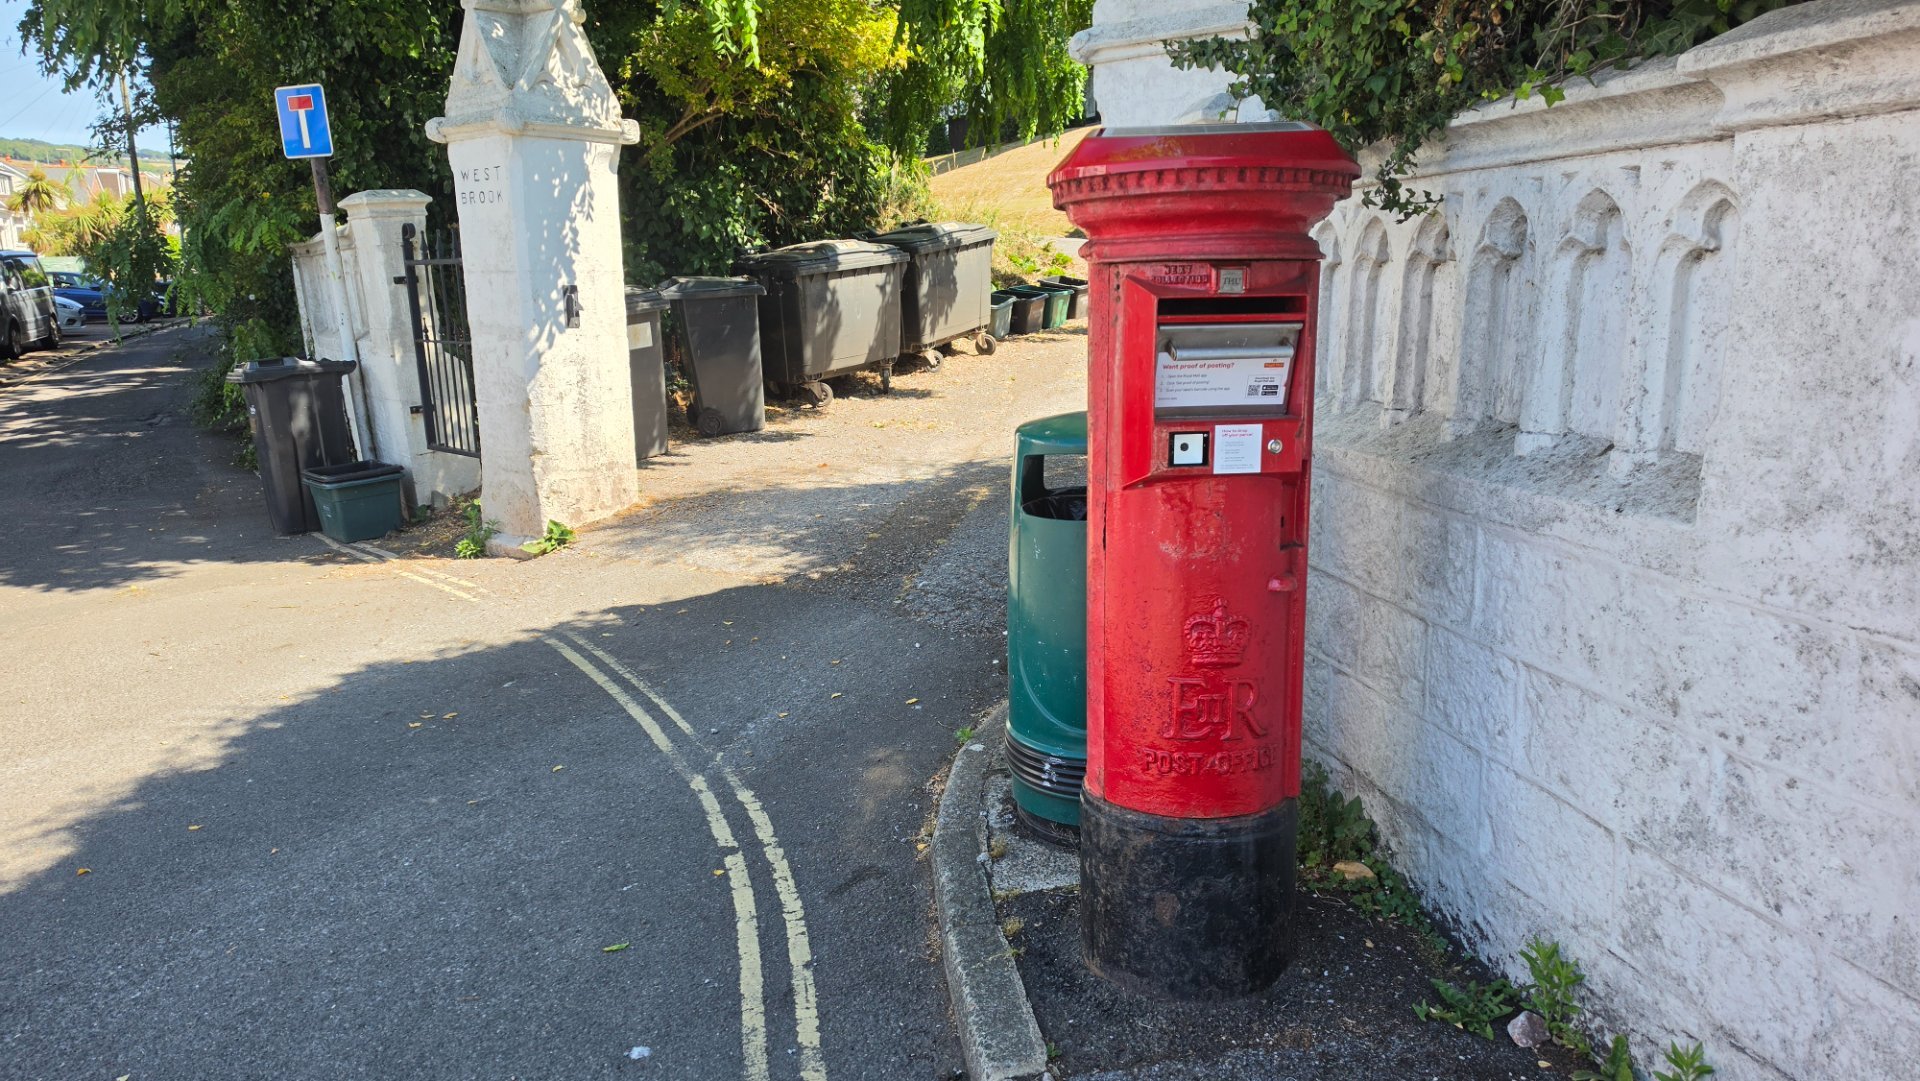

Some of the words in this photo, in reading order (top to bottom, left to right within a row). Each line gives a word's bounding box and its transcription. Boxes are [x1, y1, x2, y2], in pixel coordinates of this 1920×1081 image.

[460, 165, 501, 182] WEST
[461, 190, 504, 204] BROOK
[1207, 362, 1235, 370] posting?
[1142, 748, 1201, 775] POST
